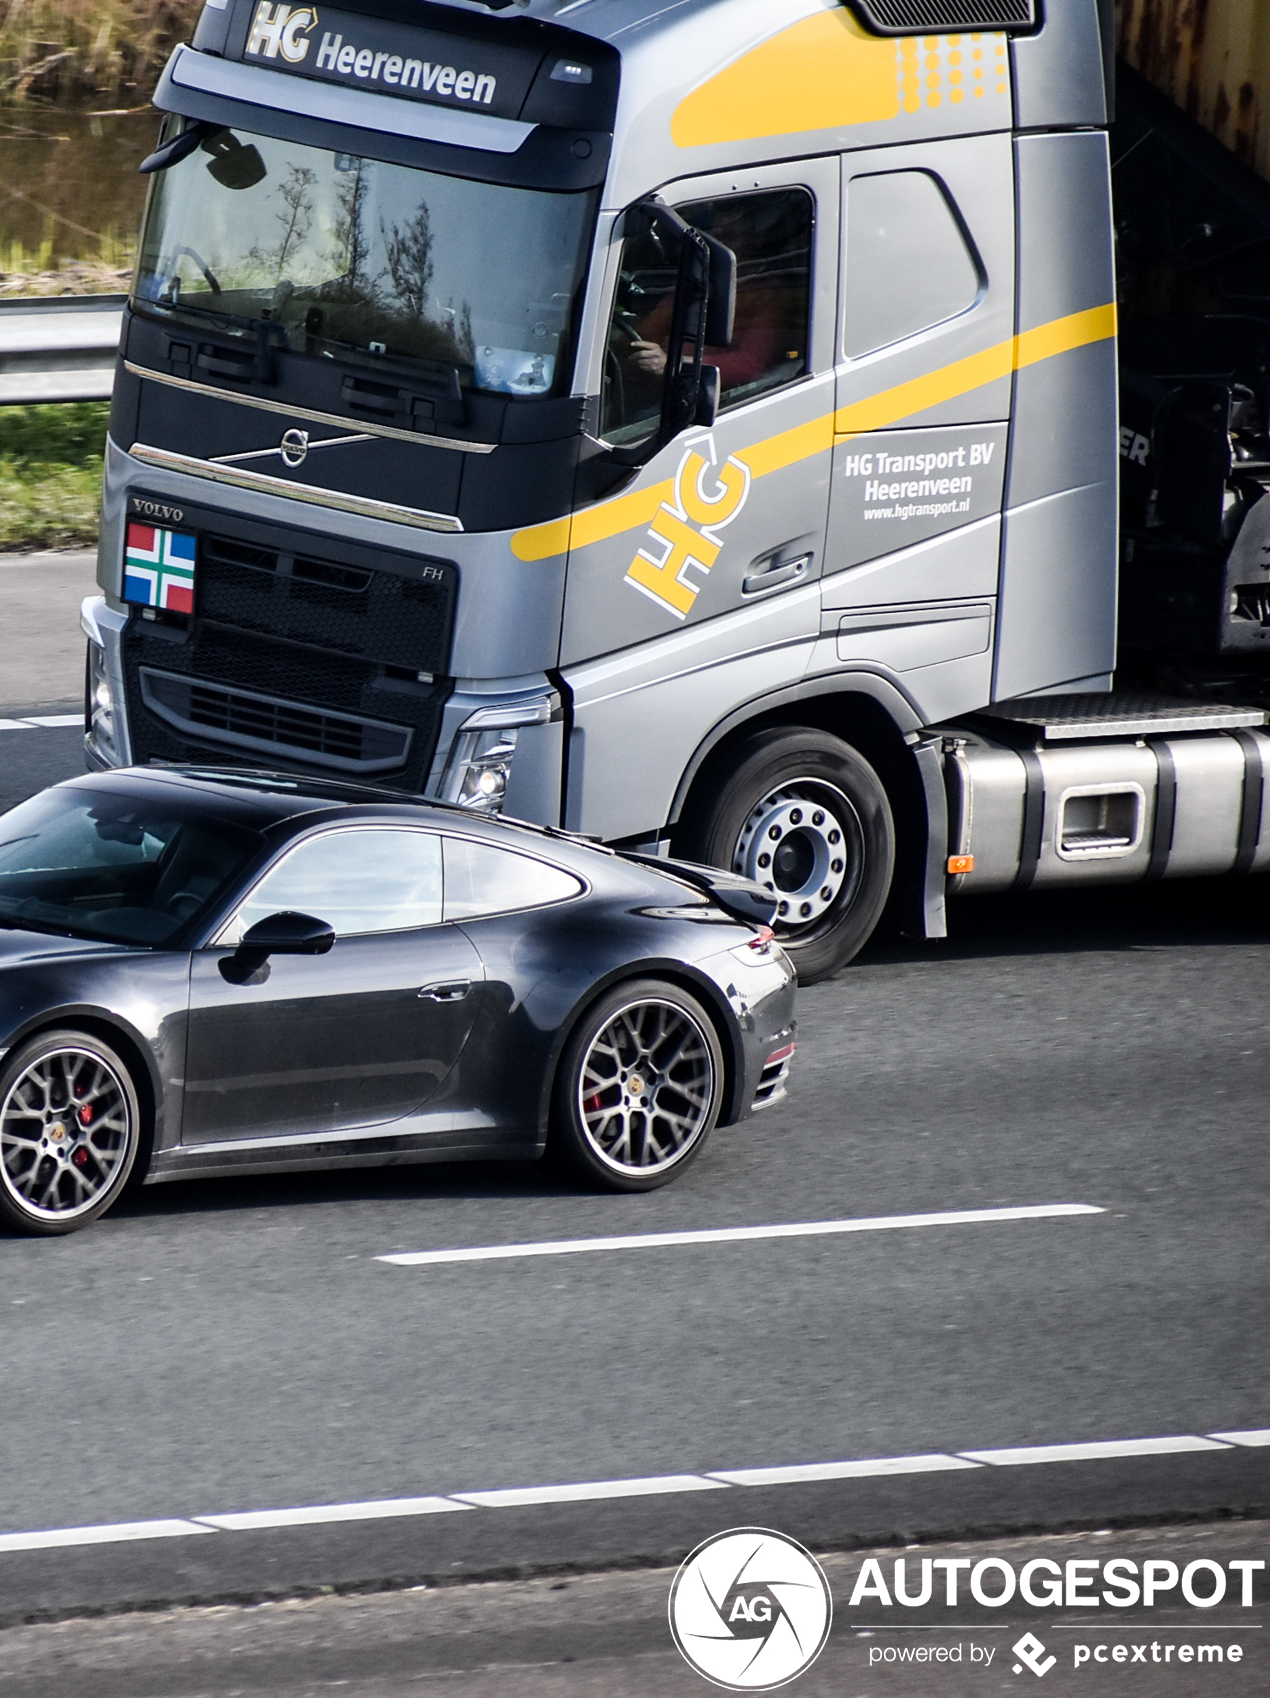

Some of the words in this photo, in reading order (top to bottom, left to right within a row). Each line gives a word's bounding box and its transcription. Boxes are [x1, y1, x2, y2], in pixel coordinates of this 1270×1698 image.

[246, 1, 318, 63] HG
[316, 32, 497, 104] Heerenveen
[845, 453, 873, 477] HG
[876, 446, 966, 475] Transport
[969, 442, 995, 466] BV
[864, 476, 972, 501] Heerenveen
[133, 498, 184, 521] VOLVO
[864, 497, 970, 520] www.hgtransport.nl
[623, 433, 751, 620] HG
[422, 566, 444, 580] FH
